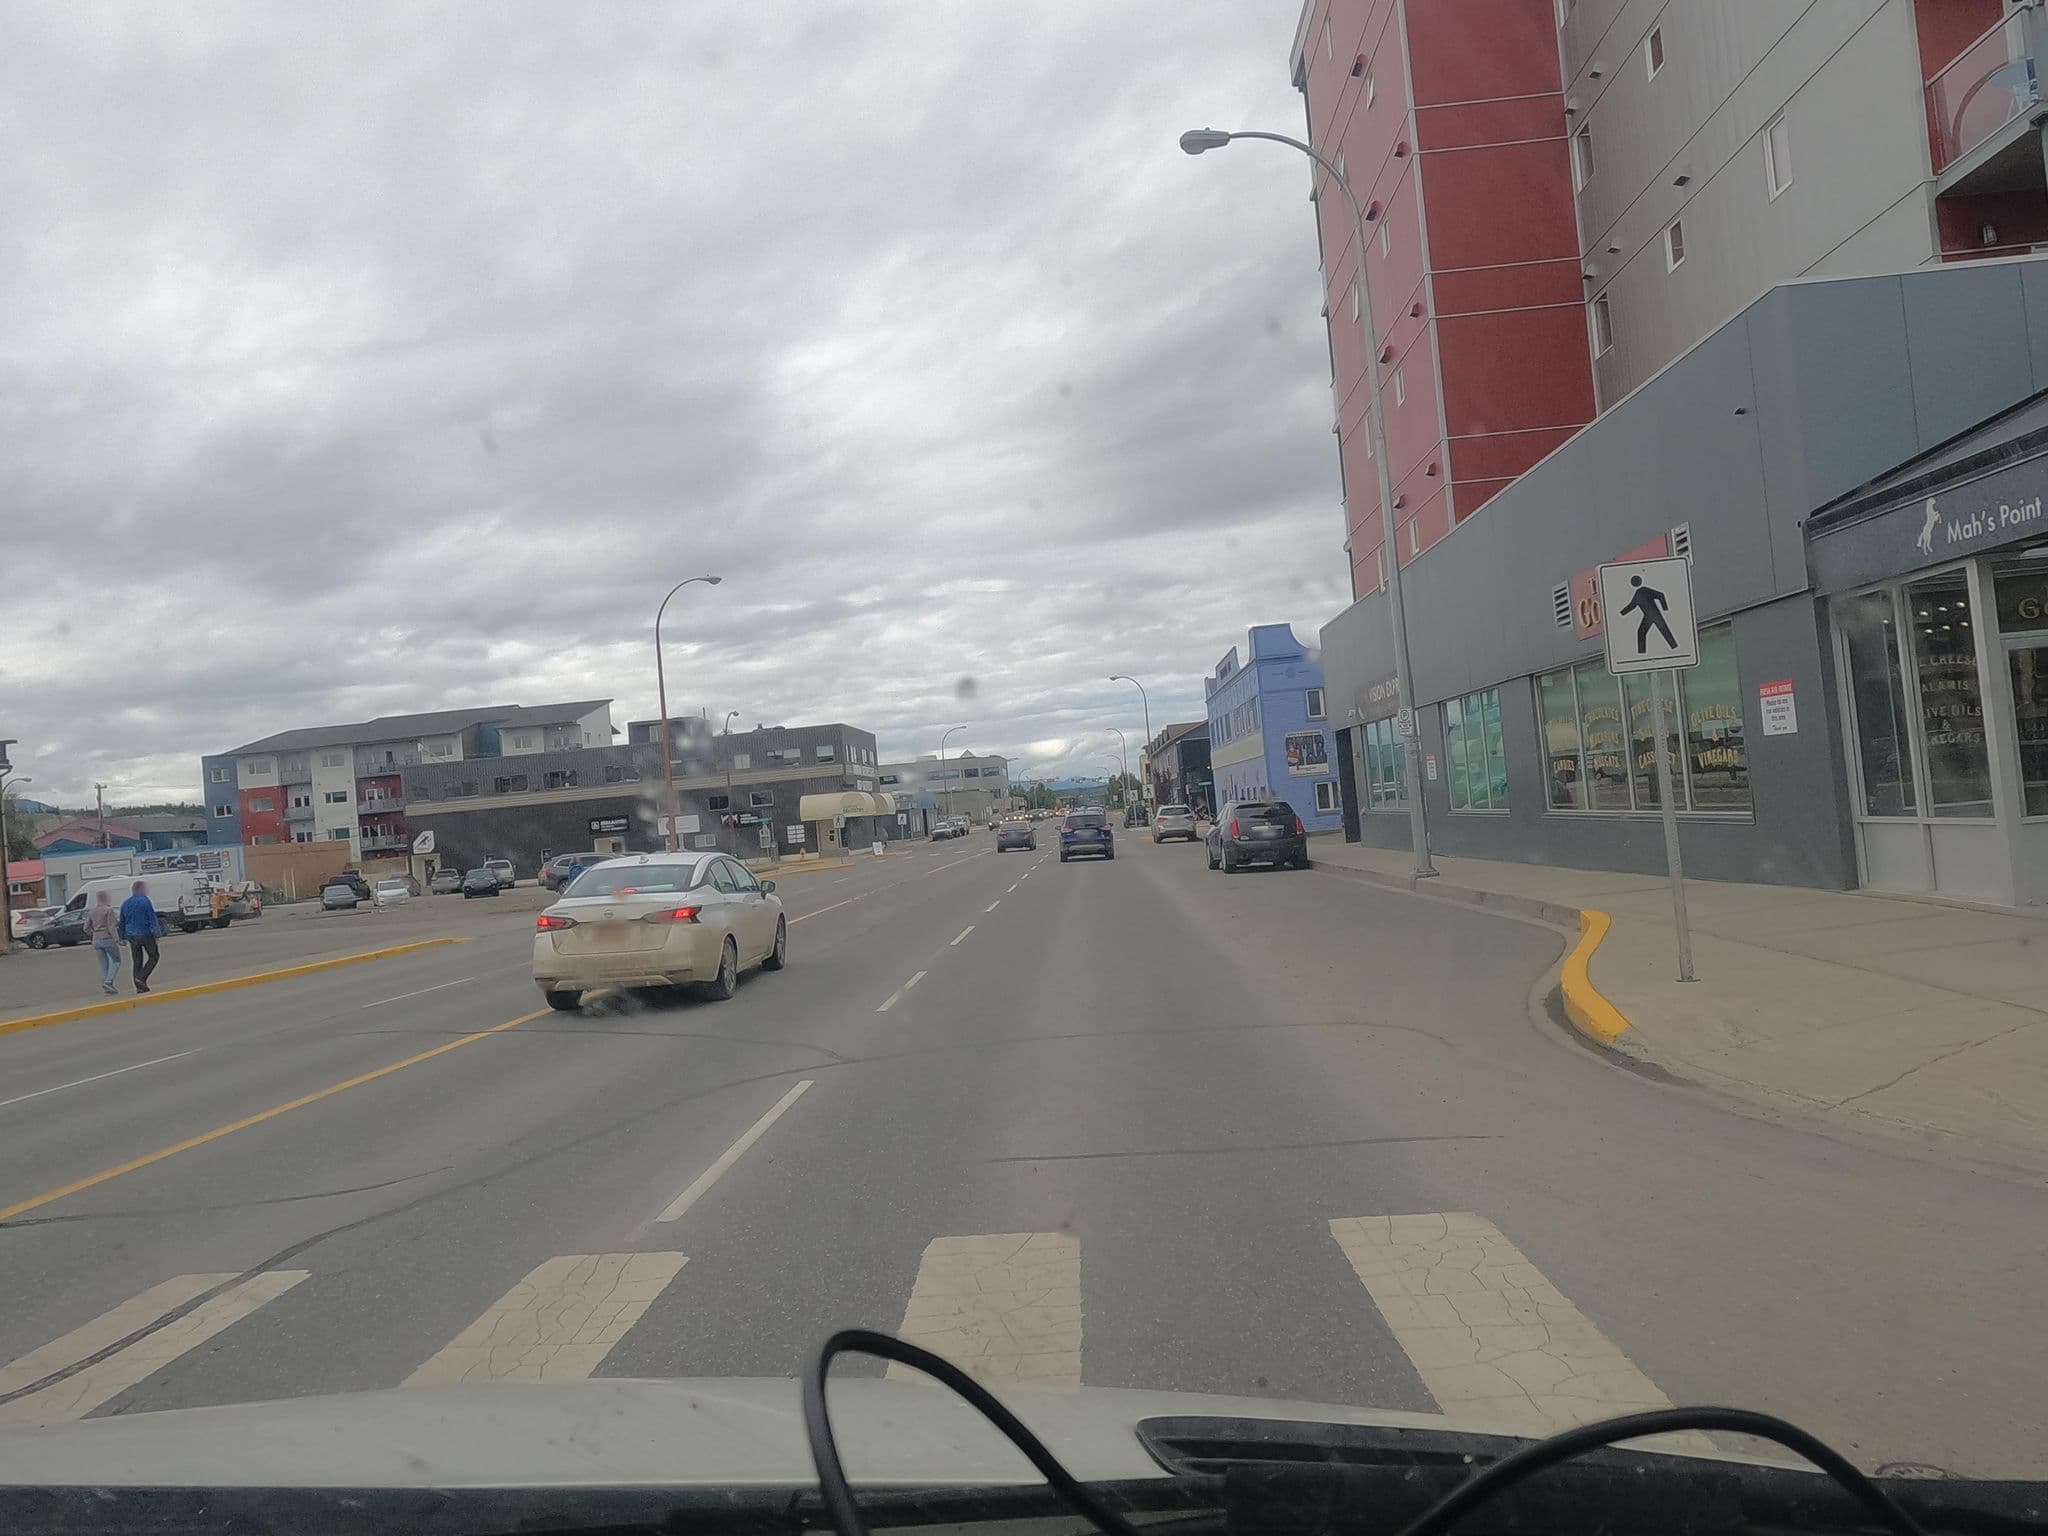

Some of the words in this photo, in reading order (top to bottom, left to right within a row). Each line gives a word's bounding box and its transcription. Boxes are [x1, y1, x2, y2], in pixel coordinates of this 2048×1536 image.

[1947, 510, 1996, 544] Mah's
[2000, 496, 2042, 528] Point
[1922, 679, 1970, 693] ALAMIS
[1691, 705, 1715, 728] OLIVE
[1716, 703, 1737, 720] OILS
[1951, 703, 1982, 717] OILS
